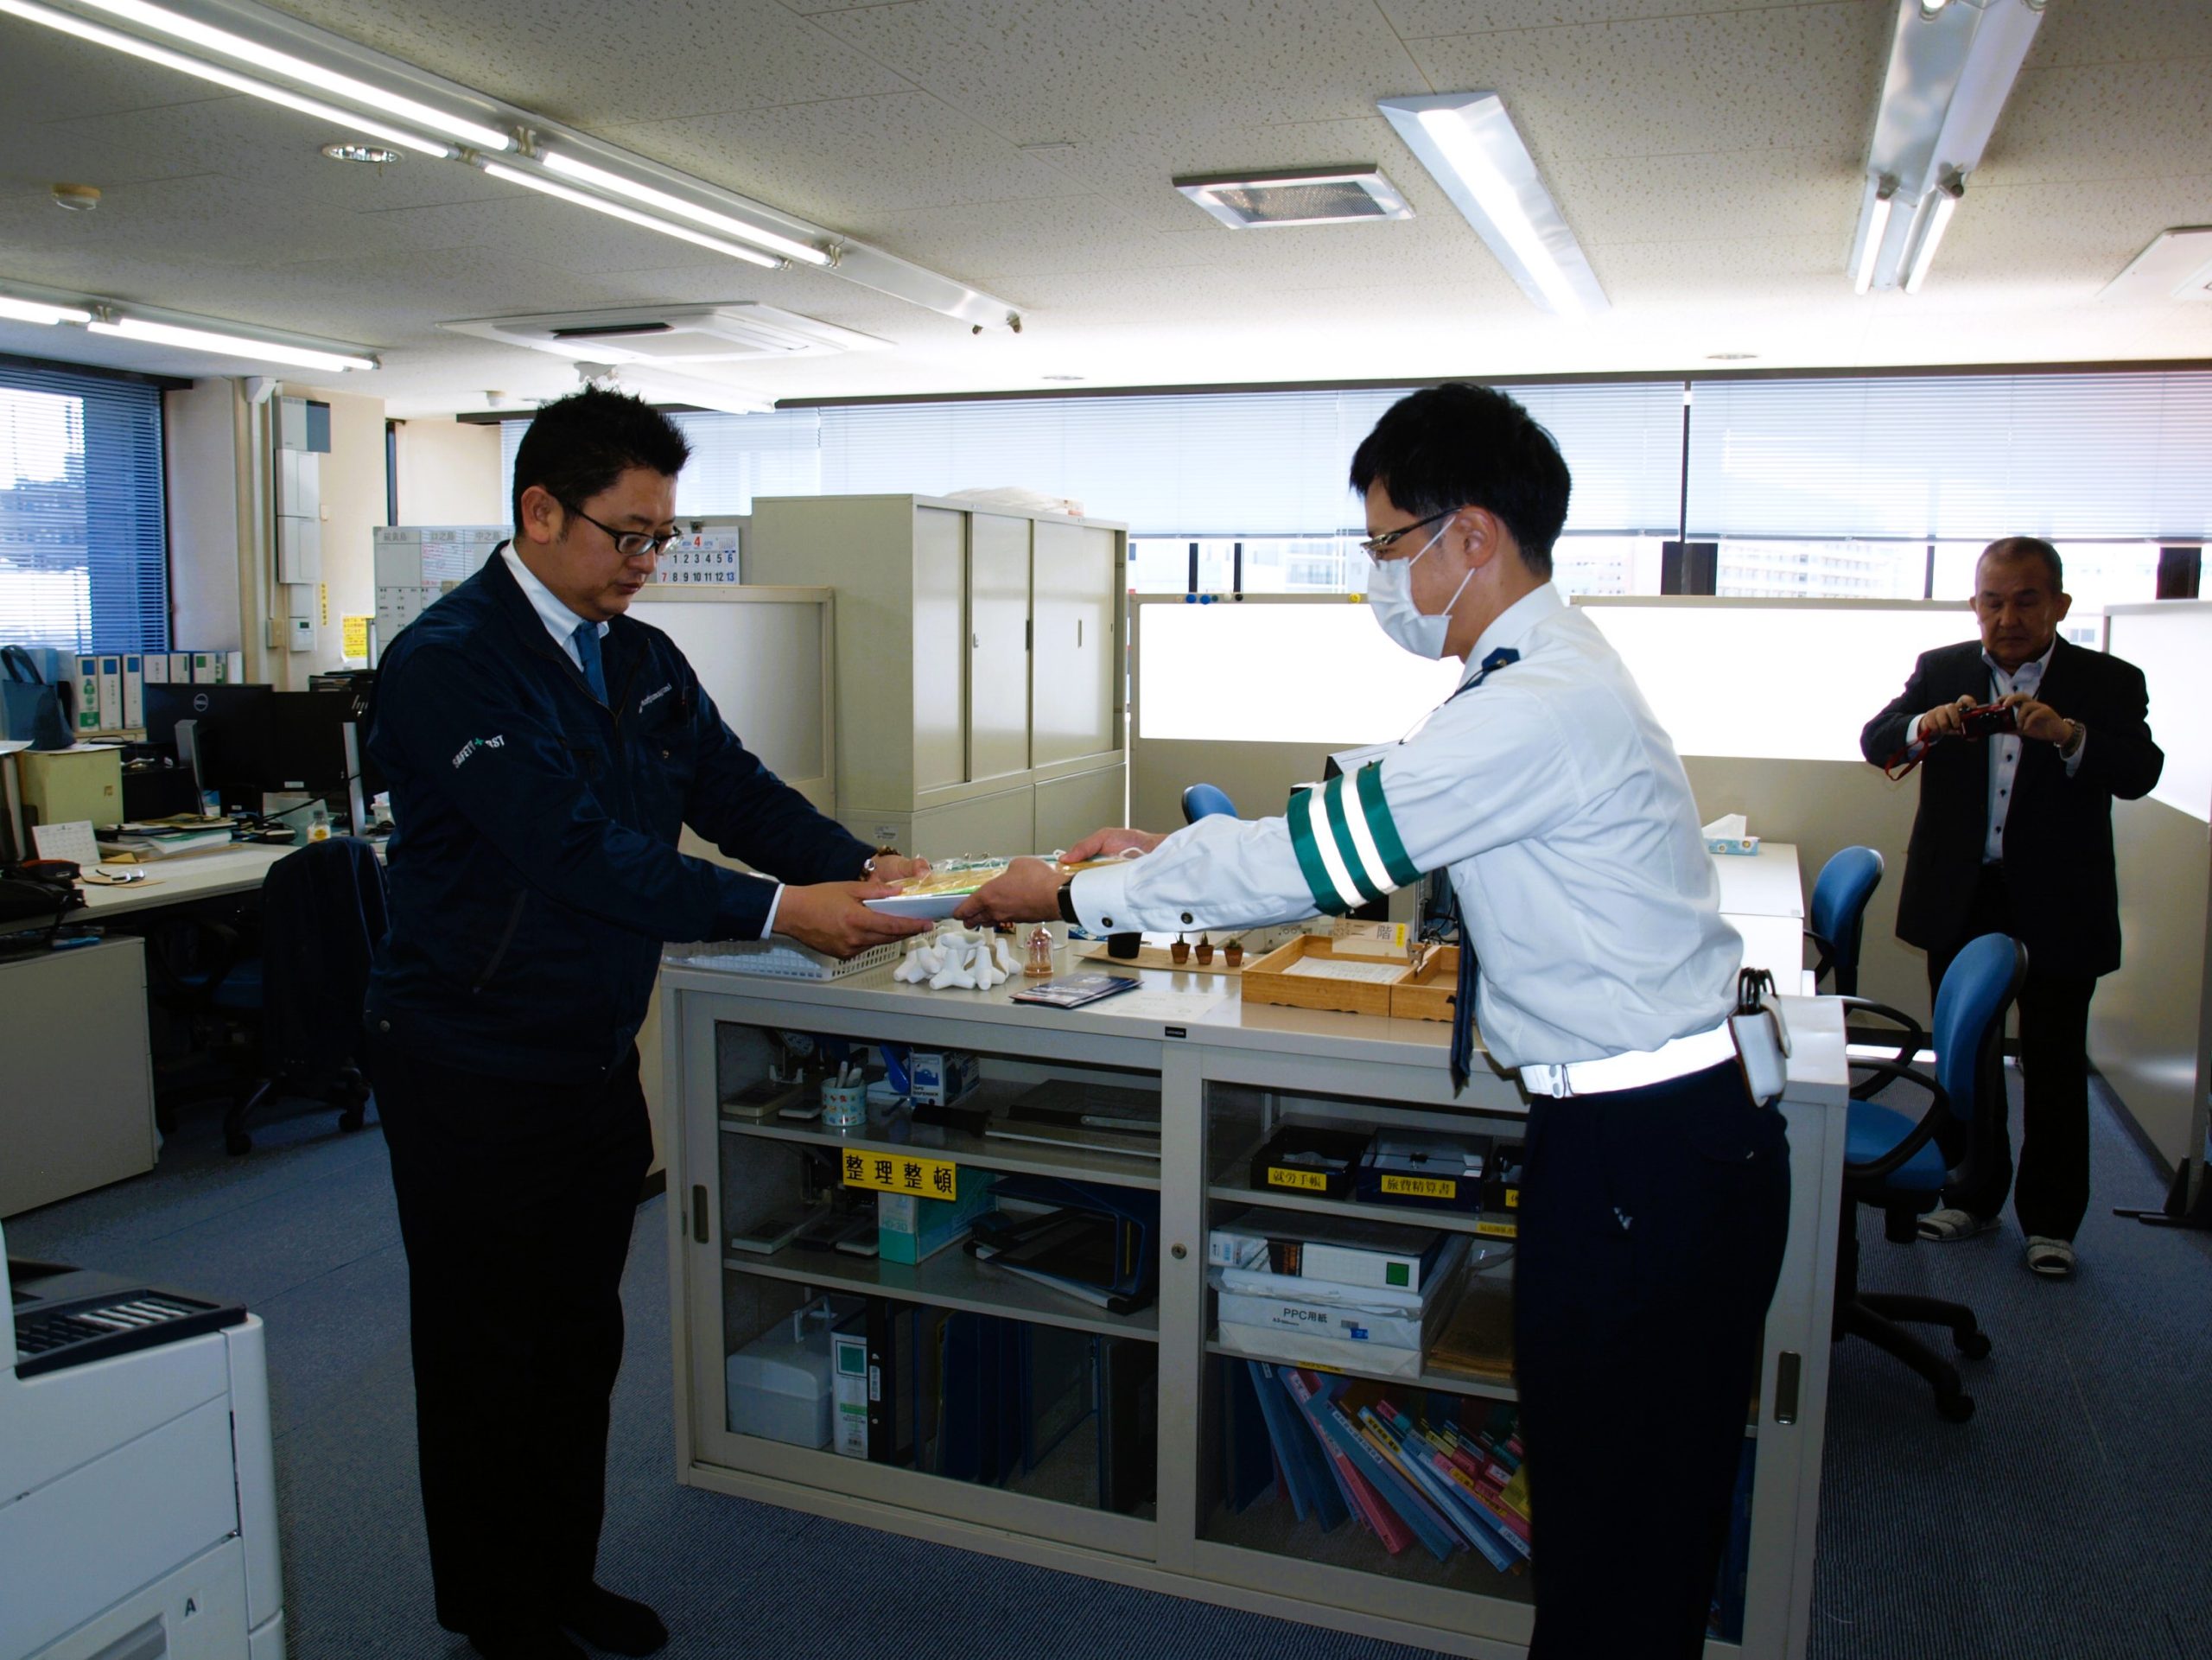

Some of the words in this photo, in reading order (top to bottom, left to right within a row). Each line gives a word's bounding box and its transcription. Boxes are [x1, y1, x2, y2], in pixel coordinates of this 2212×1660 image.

[693, 536, 702, 547] 4
[672, 554, 677, 564] 1
[683, 554, 690, 564] 2
[694, 554, 700, 564] 3
[705, 554, 711, 563] 4
[716, 554, 722, 563] 5
[728, 553, 734, 563] 6
[661, 572, 667, 582] 7
[672, 572, 678, 582] 8
[683, 572, 689, 582] 9
[693, 572, 702, 582] 10
[704, 572, 712, 582] 11
[715, 572, 724, 582] 12
[726, 571, 735, 582] 13
[845, 1154, 954, 1194] 整理整頓
[1272, 1169, 1322, 1188] 就労手帳
[1385, 1177, 1452, 1196] 旅費精算書
[1283, 1307, 1329, 1324] PPC用紙
[184, 1597, 197, 1617] A
